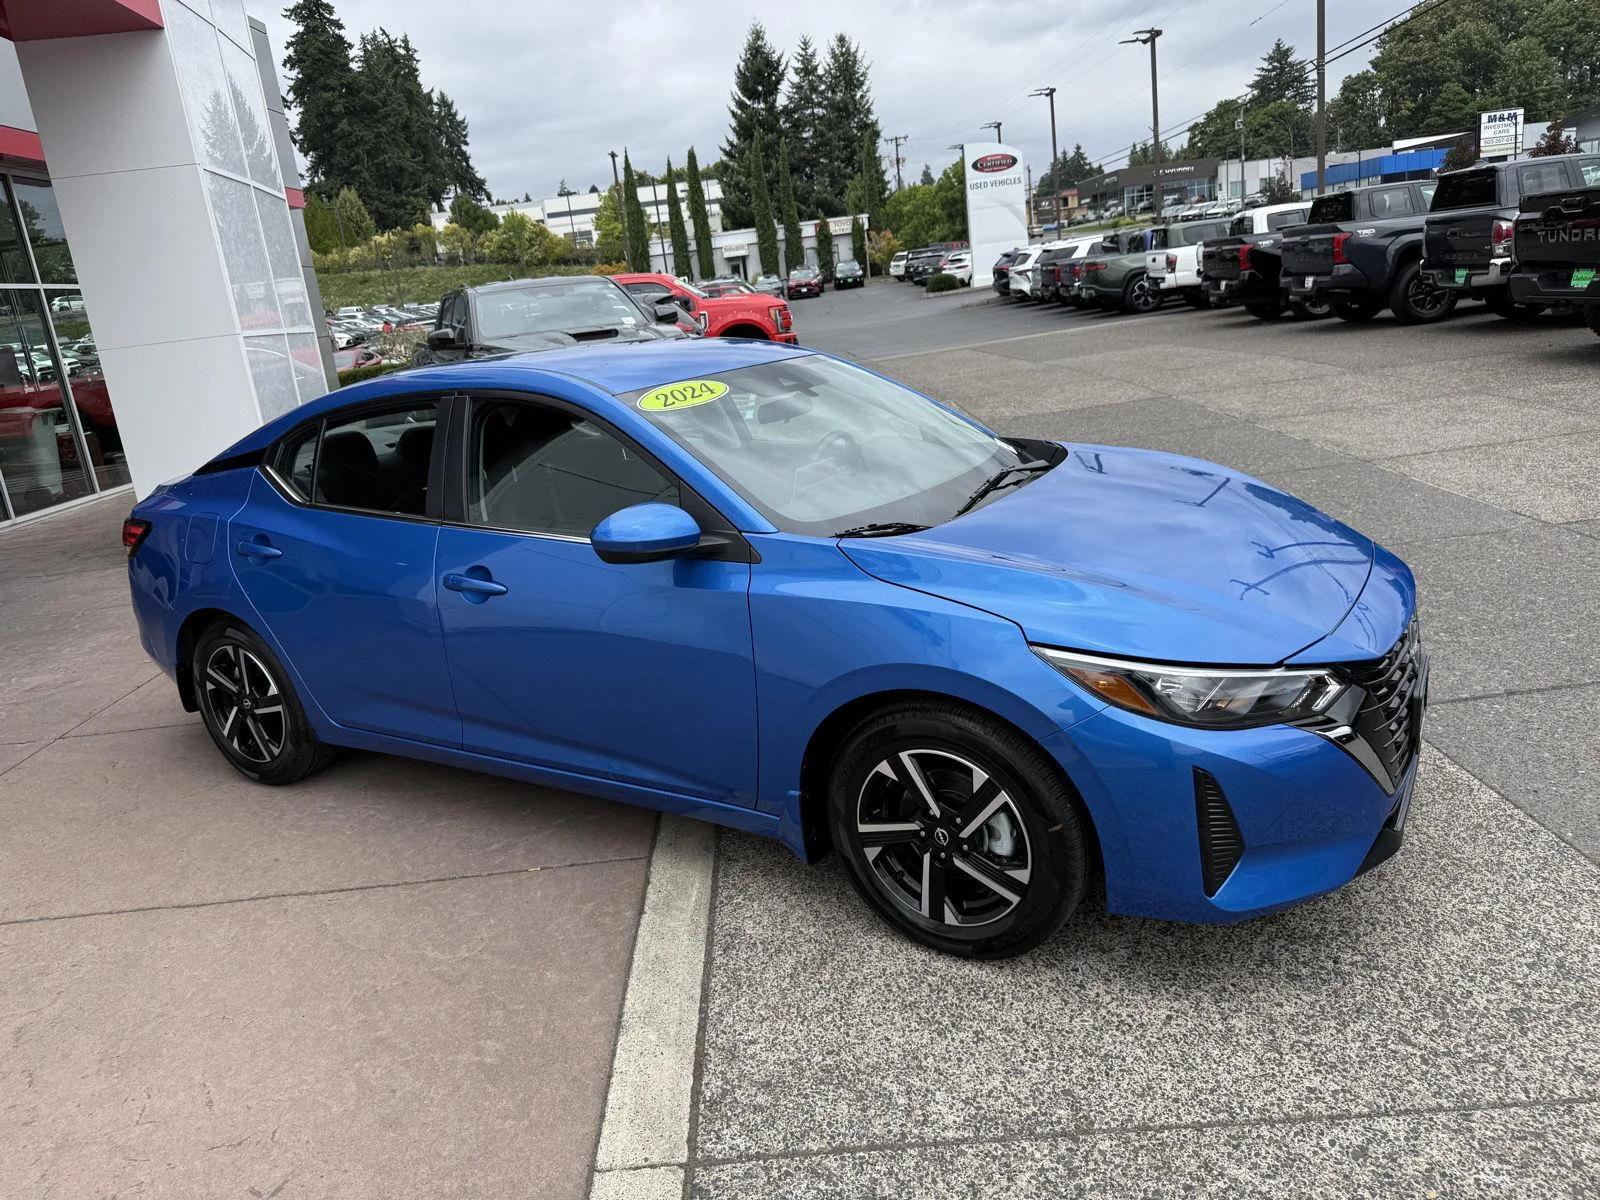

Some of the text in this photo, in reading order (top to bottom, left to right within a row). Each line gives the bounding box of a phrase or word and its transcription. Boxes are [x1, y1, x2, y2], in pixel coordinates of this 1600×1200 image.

[1487, 112, 1517, 123] M&M
[1484, 122, 1520, 130] INVESTMET
[978, 160, 1012, 168] CERTIFIED
[969, 177, 1021, 190] USED VEHICLES
[1538, 228, 1600, 243] TUNDR
[656, 382, 716, 408] 2024
